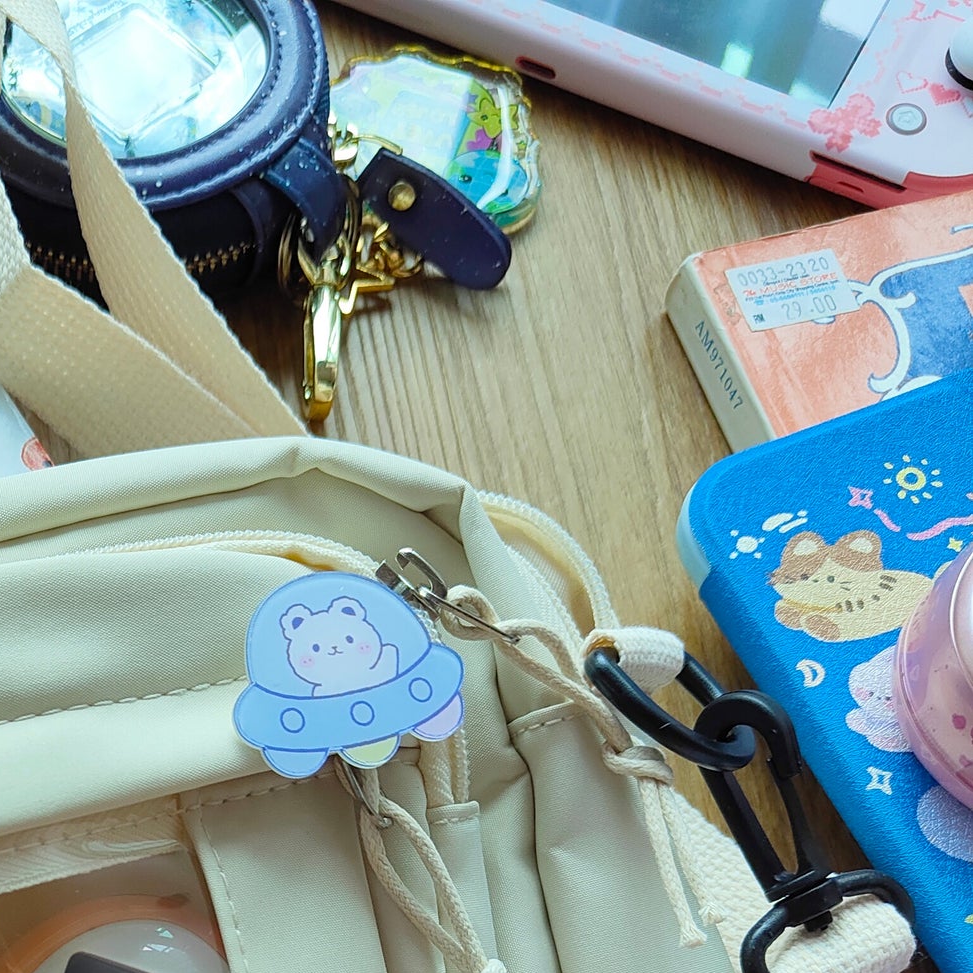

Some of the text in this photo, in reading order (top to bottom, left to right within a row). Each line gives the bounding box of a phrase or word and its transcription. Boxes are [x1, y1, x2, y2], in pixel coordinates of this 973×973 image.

[760, 281, 796, 293] MUSIC
[800, 272, 838, 286] STORE
[695, 321, 744, 409] AM971047
